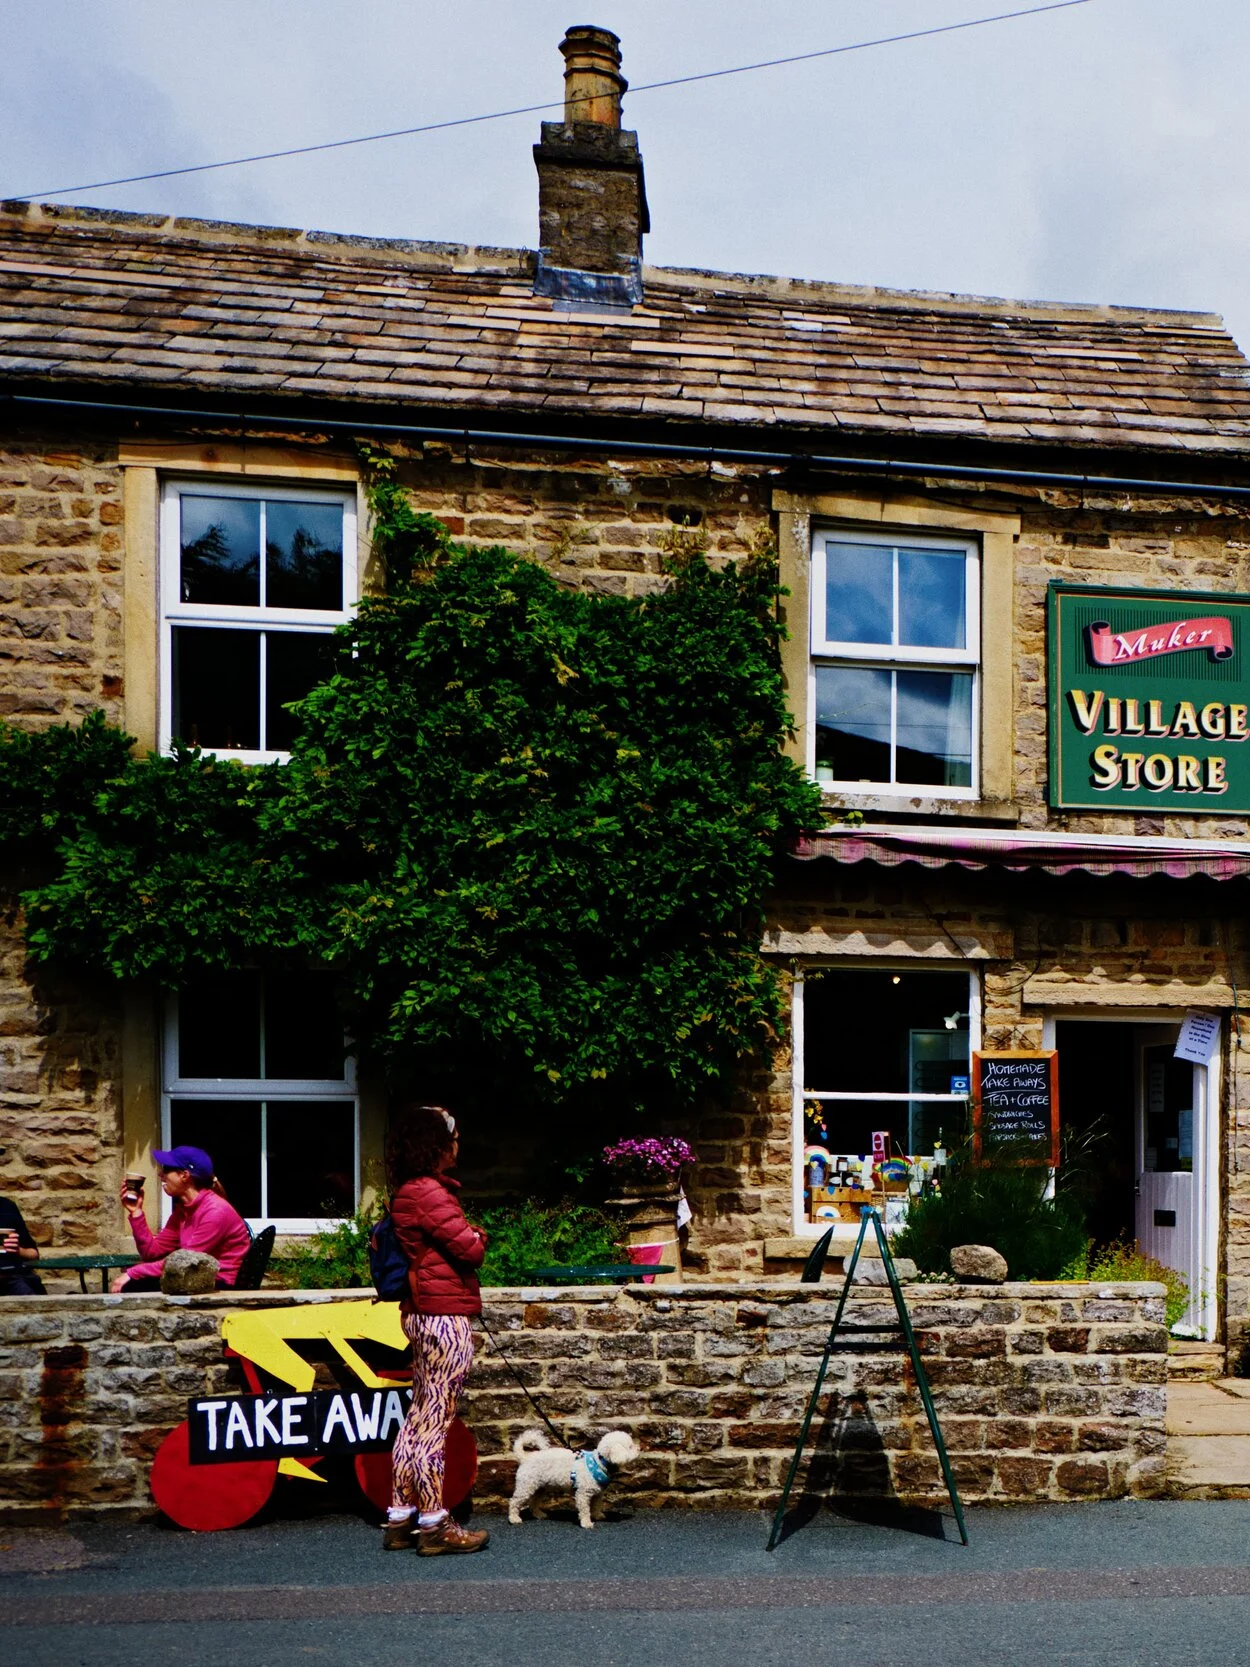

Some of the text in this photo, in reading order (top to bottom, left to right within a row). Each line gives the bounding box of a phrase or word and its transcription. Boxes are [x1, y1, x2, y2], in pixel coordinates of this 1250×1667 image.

[1114, 622, 1213, 661] Muker
[1066, 689, 1250, 742] VILLAGE
[1089, 744, 1228, 795] STORE
[981, 1074, 1047, 1090] TAKE AWAYS
[988, 1062, 1046, 1075] HOMEMADE
[983, 1093, 1009, 1107] TEA
[1017, 1093, 1050, 1106] COFFEE
[988, 1120, 1046, 1131] SAUSAGE ROLLS
[197, 1388, 413, 1451] TAKE AWA
